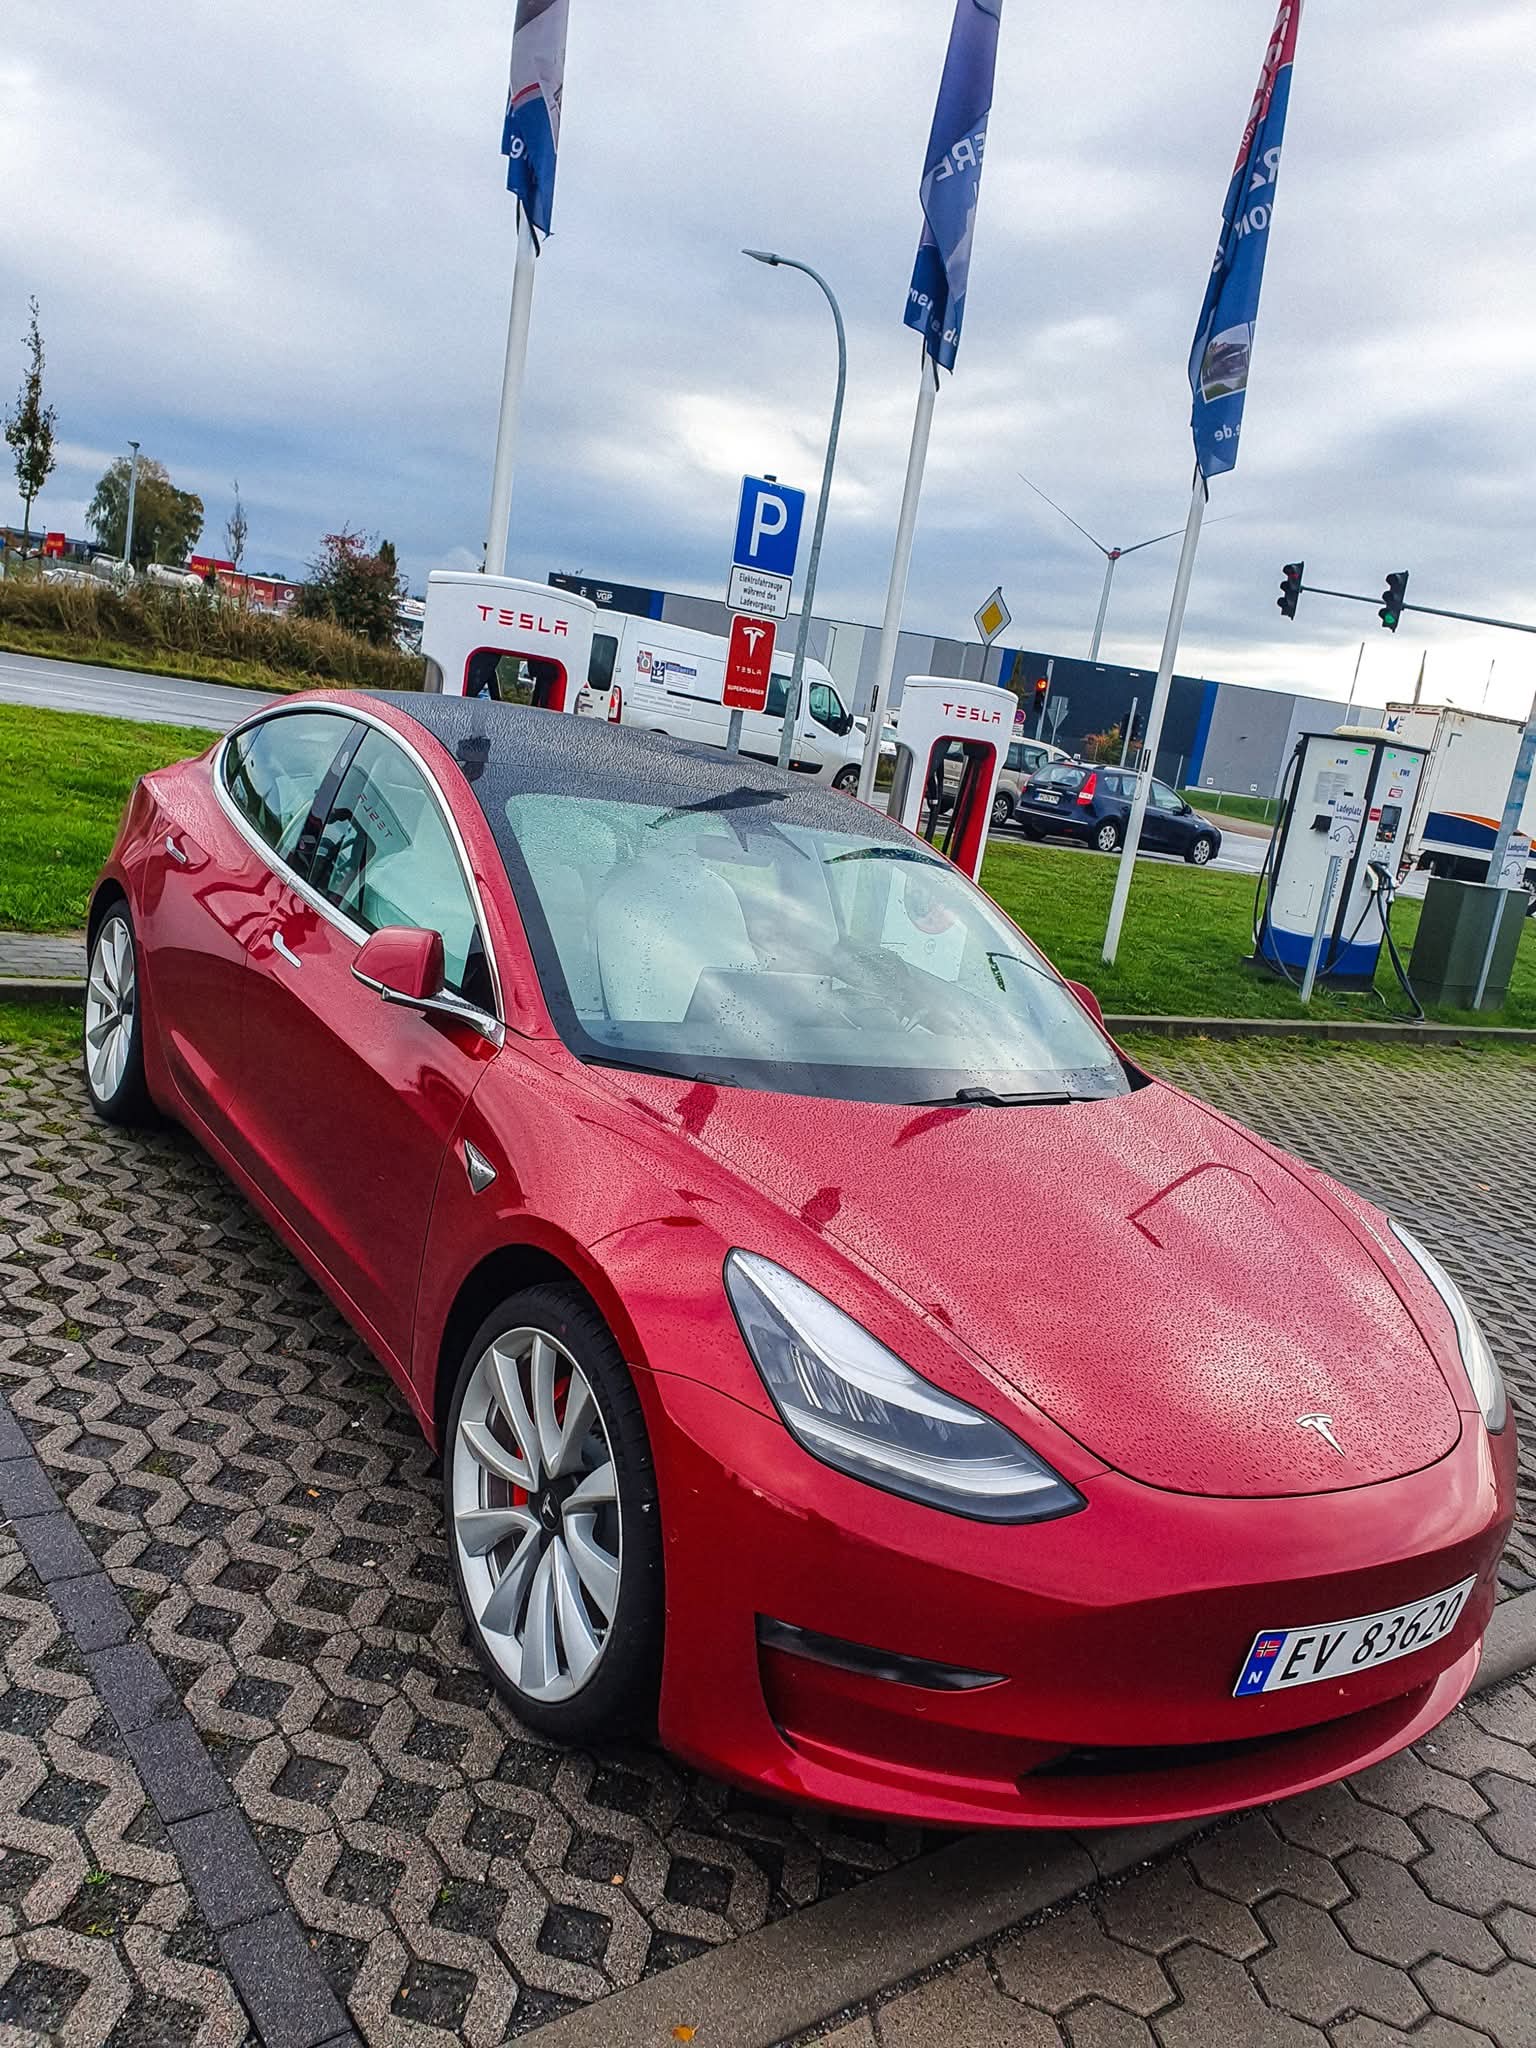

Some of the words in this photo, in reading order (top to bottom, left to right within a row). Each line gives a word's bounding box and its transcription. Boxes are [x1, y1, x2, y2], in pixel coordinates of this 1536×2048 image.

[749, 492, 787, 557] P
[739, 572, 783, 592] Elektrofahrzeuge
[743, 586, 766, 599] während
[767, 590, 776, 601] des
[740, 596, 776, 612] Ladevorgangs
[477, 604, 569, 637] TESLA
[736, 665, 762, 676] TESLA
[727, 684, 765, 695] SUPERCHARGER
[943, 703, 1001, 724] TESLA
[1280, 1631, 1348, 1681] EV
[1352, 1591, 1463, 1665] 83620
[1248, 1670, 1262, 1684] N
